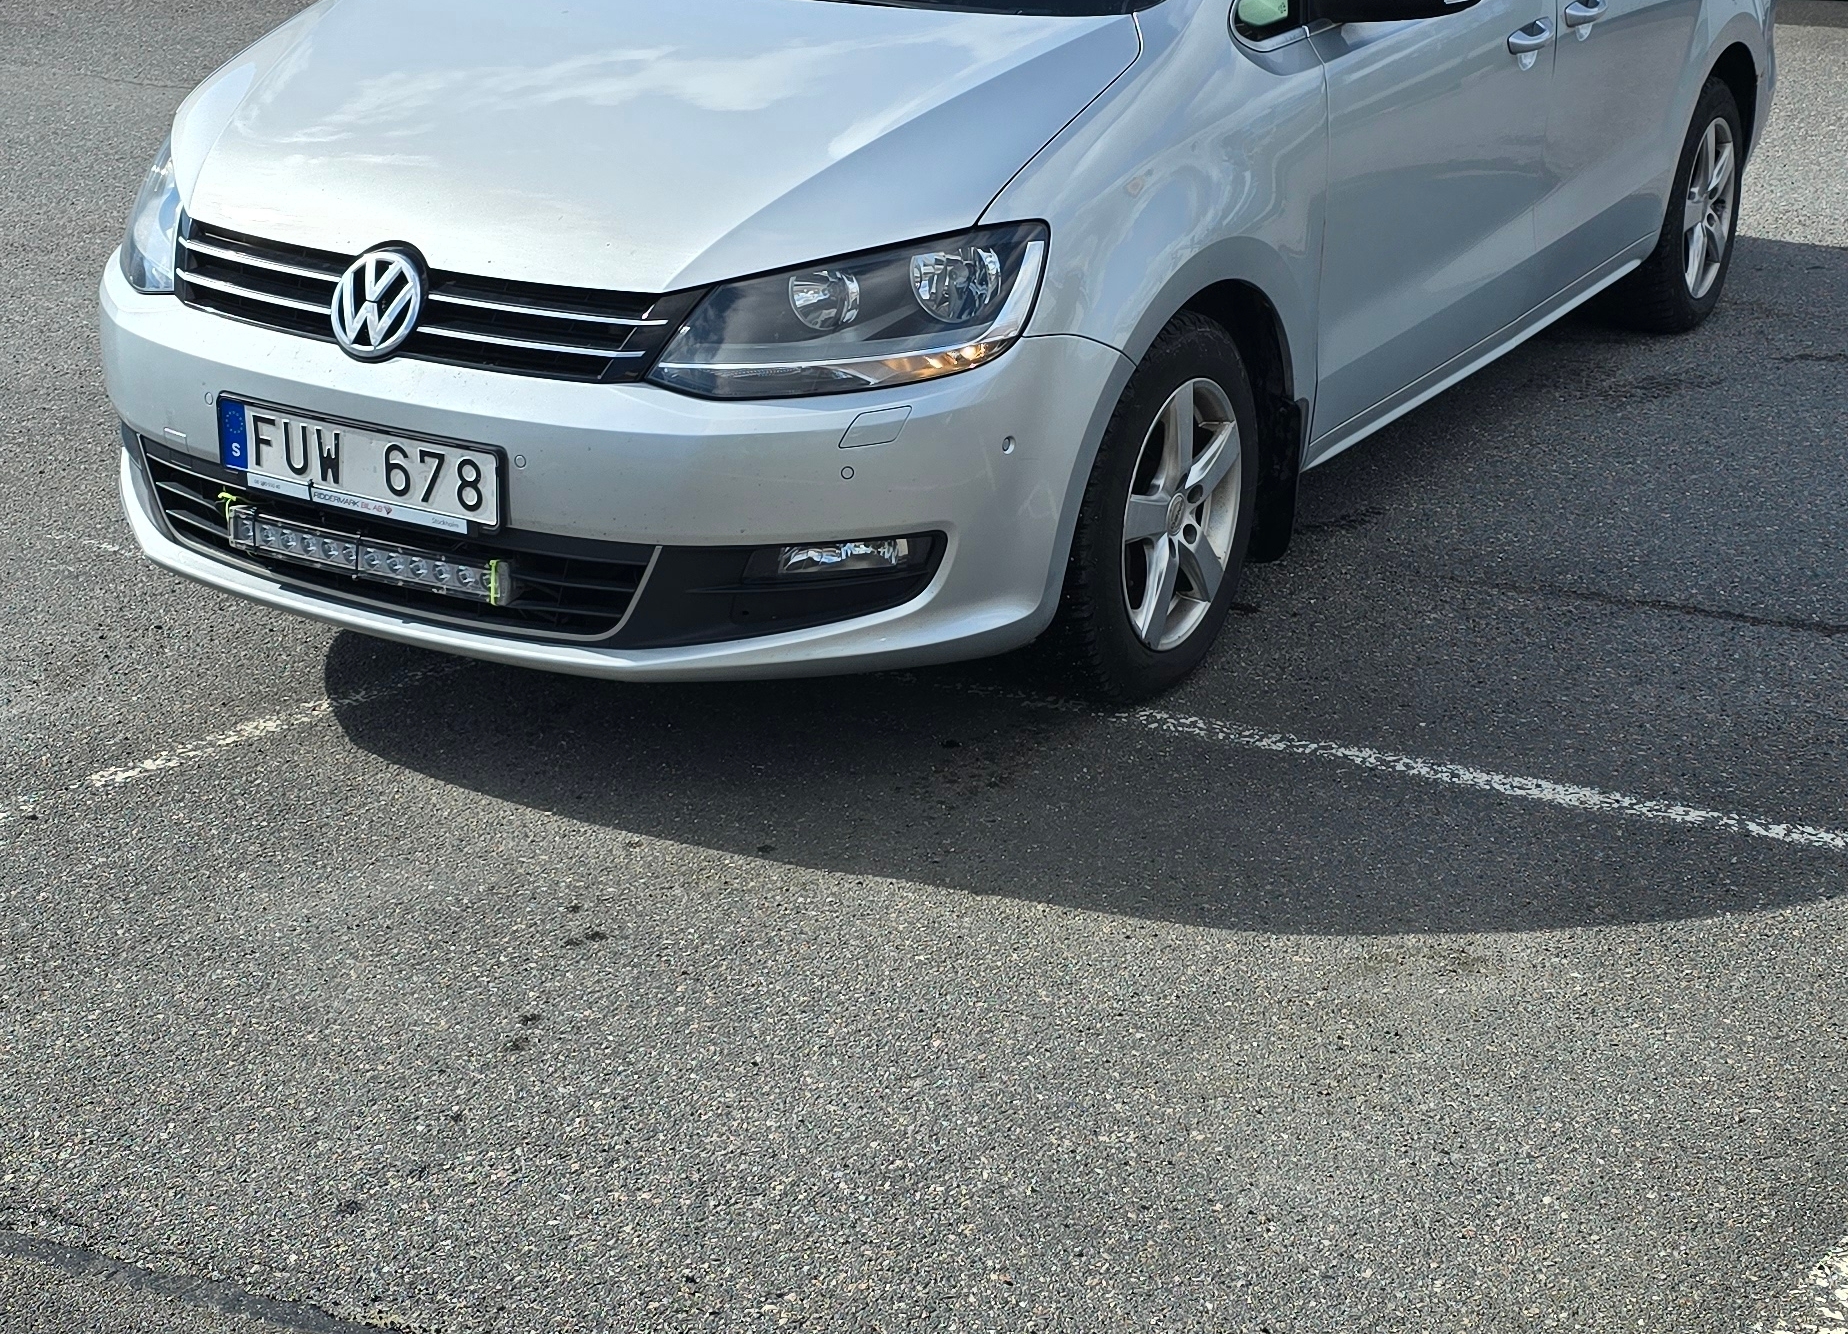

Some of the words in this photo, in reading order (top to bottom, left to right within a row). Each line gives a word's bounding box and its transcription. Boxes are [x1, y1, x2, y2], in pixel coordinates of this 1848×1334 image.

[231, 442, 241, 457] S
[252, 414, 340, 485] FUW
[384, 443, 483, 512] 678
[313, 491, 360, 508] RIDDERMARK
[360, 501, 372, 511] BIL
[373, 504, 384, 513] AB
